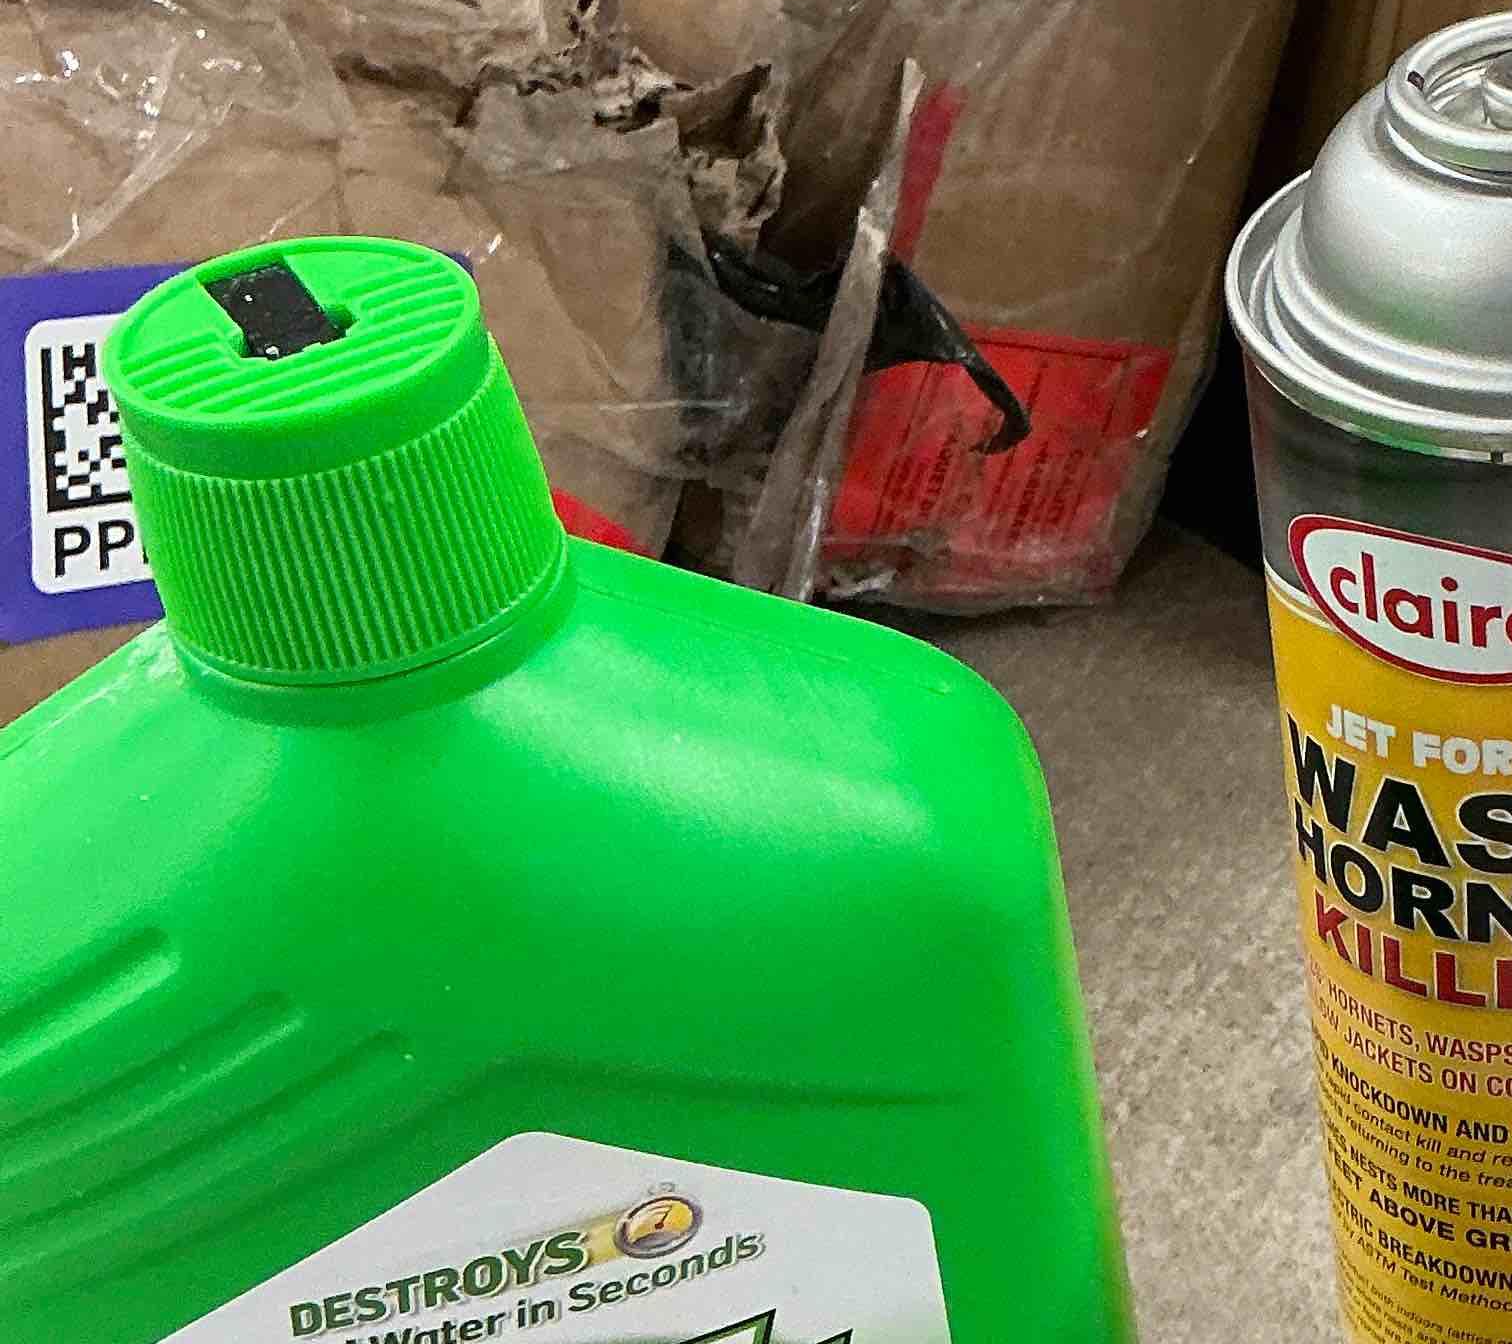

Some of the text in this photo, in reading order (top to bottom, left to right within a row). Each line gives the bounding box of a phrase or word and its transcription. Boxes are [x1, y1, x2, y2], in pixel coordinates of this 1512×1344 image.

[53, 519, 150, 579] PP
[1326, 703, 1397, 758] JET
[1328, 978, 1420, 1053] HORNETS,
[1343, 1026, 1434, 1085] JACKETS
[1441, 1068, 1477, 1095] ON
[1330, 1052, 1448, 1134] KNOCKDOWN
[1455, 1119, 1509, 1145] AND
[1354, 1103, 1411, 1143] contact
[1415, 1133, 1442, 1155] kill
[1446, 1145, 1487, 1164] and
[1345, 1113, 1410, 1166] returning
[1414, 1155, 1434, 1173] to
[1439, 1163, 1471, 1184] the
[1350, 1144, 1399, 1192] NESTS
[1402, 1180, 1462, 1217] MORE
[1369, 1187, 1457, 1242] ABOVE
[287, 1230, 589, 1338] DESTROYS
[516, 1296, 559, 1330] in
[566, 1231, 768, 1315] Seconds
